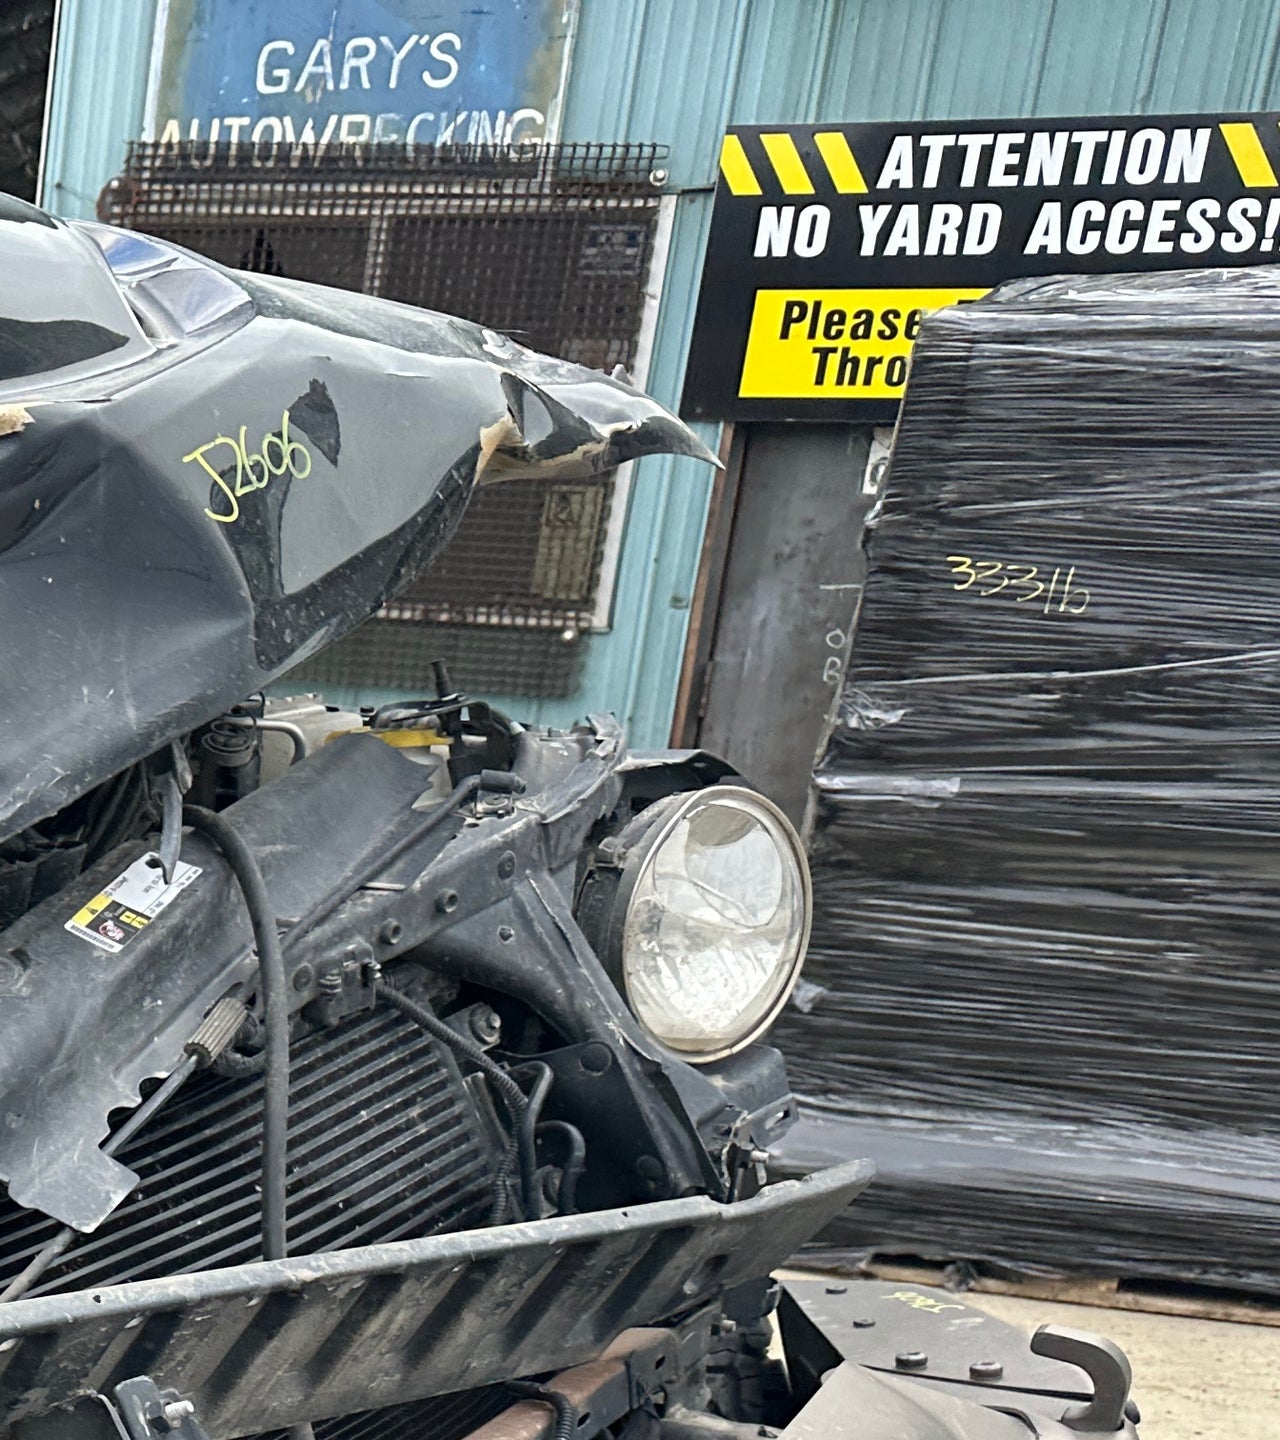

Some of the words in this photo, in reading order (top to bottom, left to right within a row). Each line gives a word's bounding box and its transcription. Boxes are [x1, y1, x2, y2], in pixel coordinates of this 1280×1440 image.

[255, 32, 462, 95] GARY'S
[875, 127, 1212, 190] ATTENTION
[753, 204, 831, 258] NO
[859, 202, 1003, 257] YARD
[779, 300, 921, 341] Please
[182, 409, 312, 523] J2606
